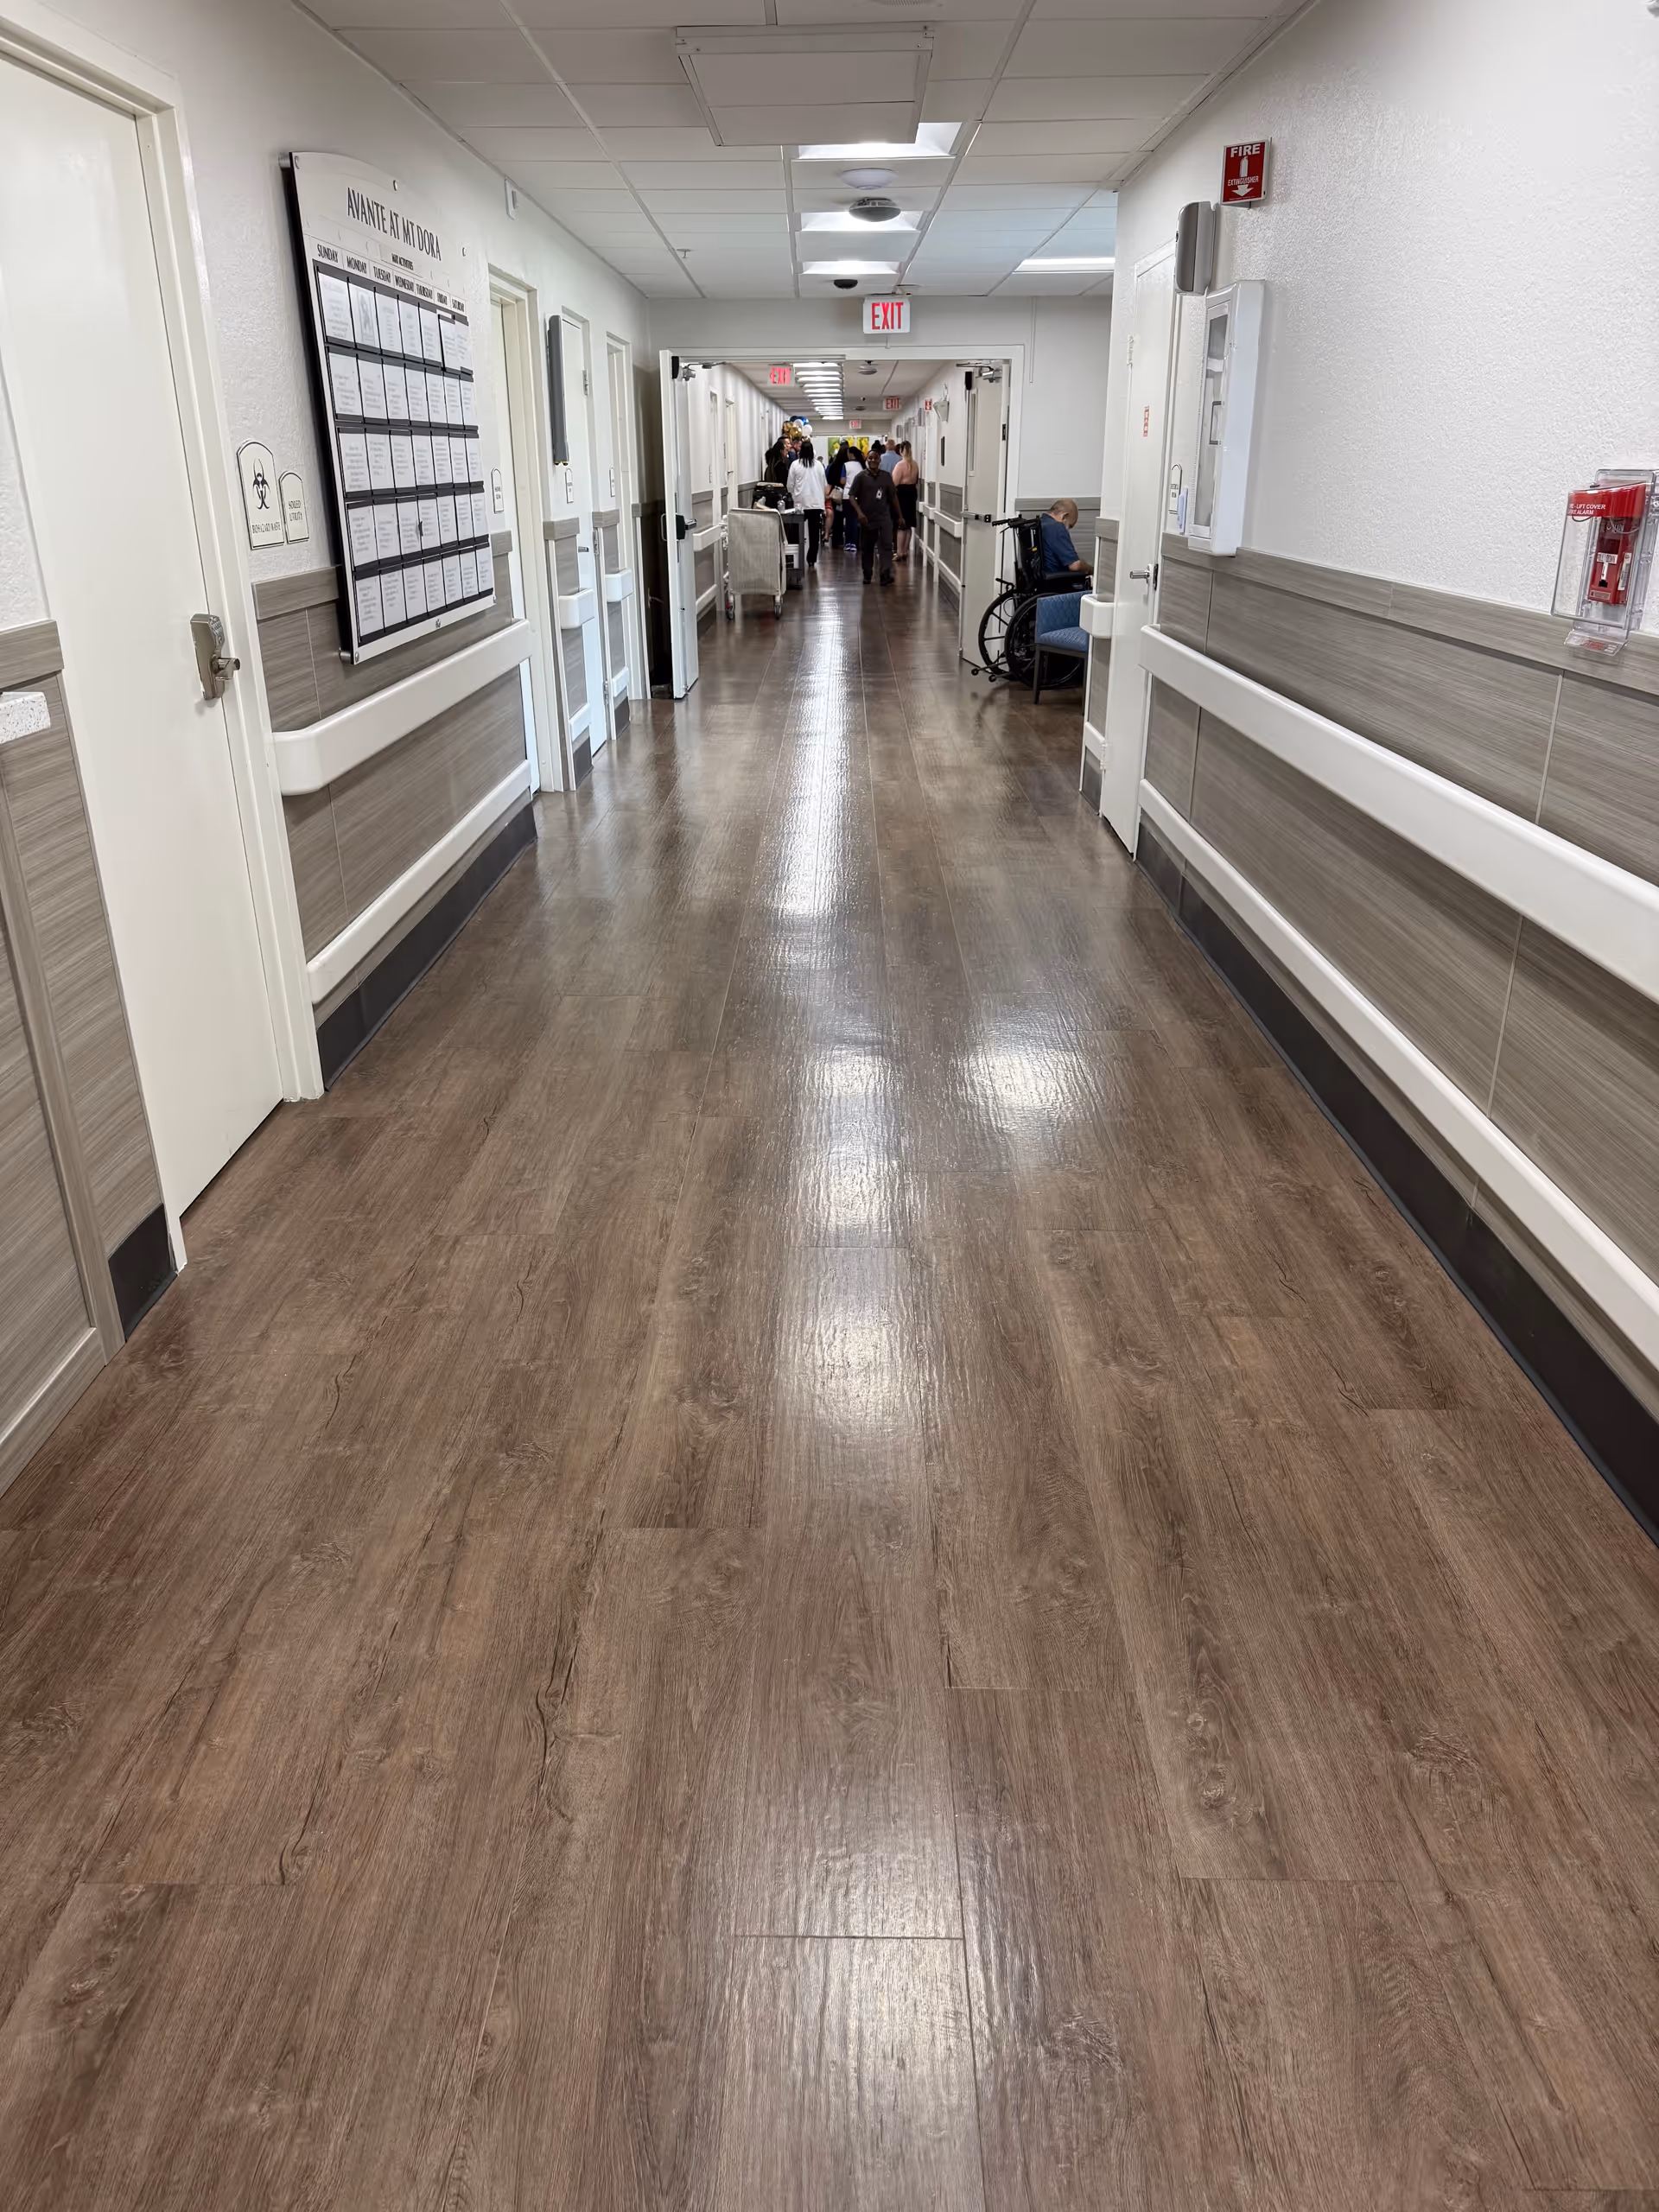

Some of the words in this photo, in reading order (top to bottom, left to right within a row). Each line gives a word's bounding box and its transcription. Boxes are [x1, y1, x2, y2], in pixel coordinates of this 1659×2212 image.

[1230, 143, 1261, 158] FIRE
[1227, 175, 1259, 187] EXTINGUISHER
[347, 187, 388, 234] AVANTE
[390, 209, 400, 240] AT
[402, 216, 416, 248] MT
[416, 225, 442, 261] DORA
[316, 244, 338, 264] SUNDAY
[346, 255, 366, 274] MONDAY
[372, 266, 391, 283] TUESDAY
[394, 275, 415, 292] WEDNESDAY
[416, 283, 433, 300] THURSDAY
[871, 302, 904, 330] EXIT
[770, 367, 791, 385] EXIT
[886, 397, 899, 410] EXIT
[288, 499, 301, 509] SOILED
[289, 512, 302, 522] UTILITY
[251, 523, 270, 534] BIOHAZARD
[270, 521, 281, 531] WASTE
